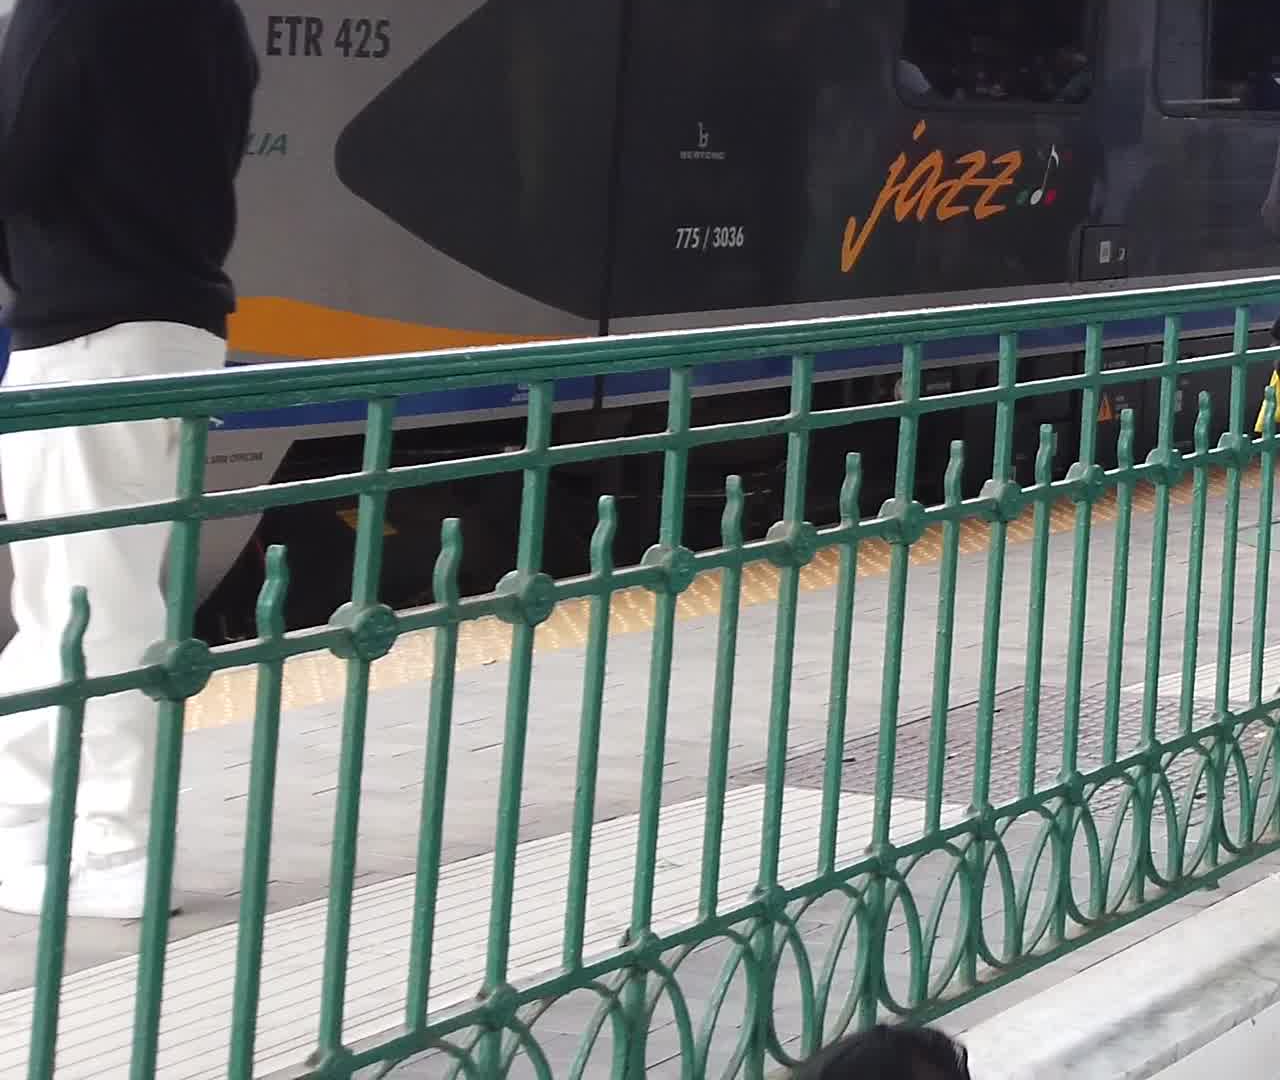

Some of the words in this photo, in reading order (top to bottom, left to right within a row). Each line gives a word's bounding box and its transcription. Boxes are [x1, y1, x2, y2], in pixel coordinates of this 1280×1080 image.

[266, 16, 323, 56] ETR
[335, 18, 391, 58] 425
[841, 119, 1023, 272] jazz
[675, 227, 700, 249] 775
[712, 226, 744, 247] 3036
